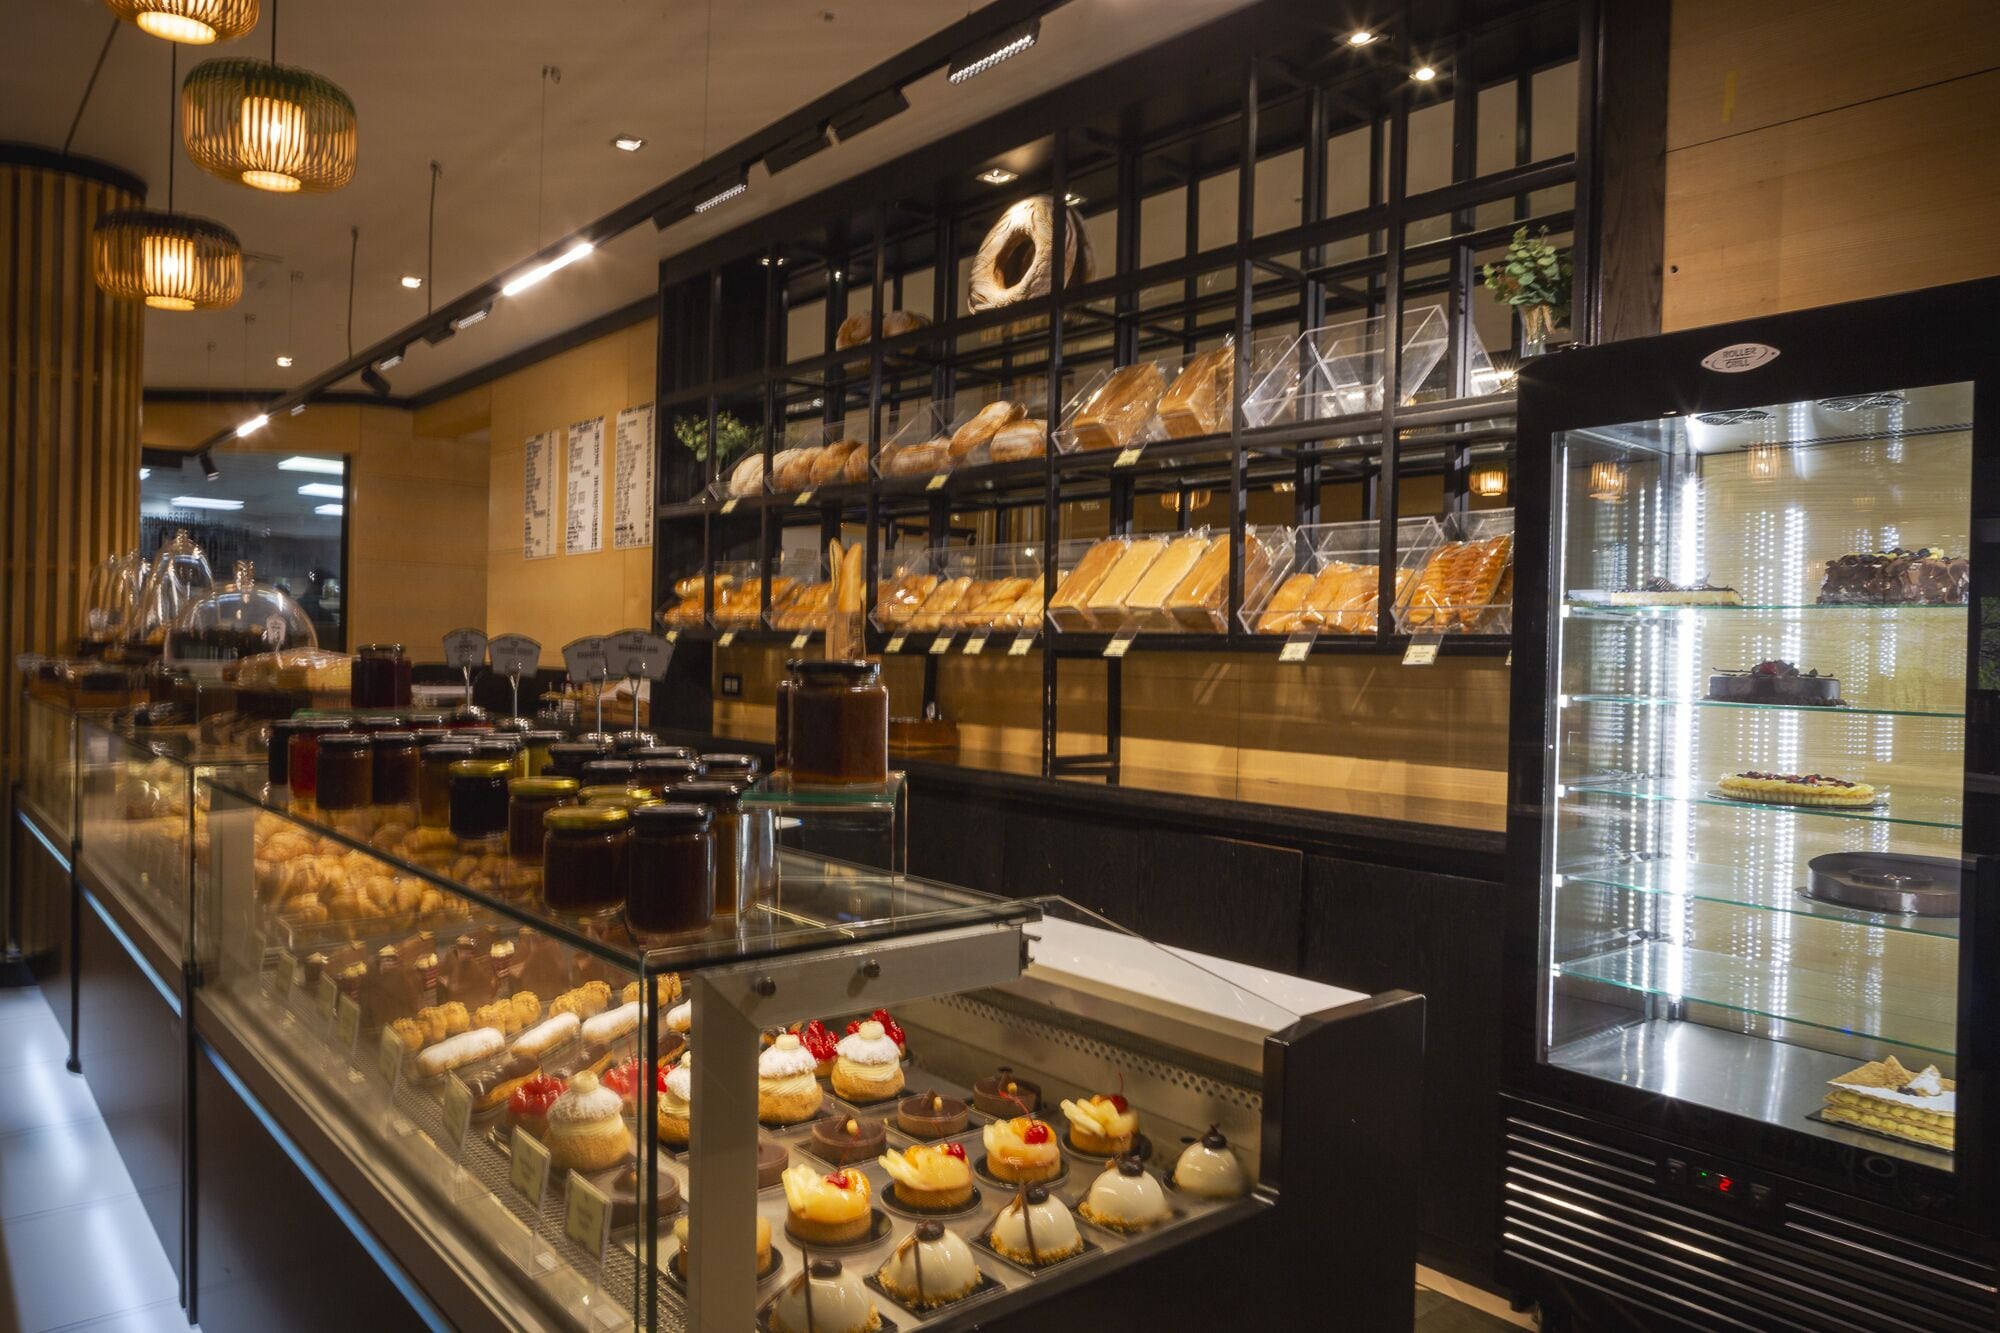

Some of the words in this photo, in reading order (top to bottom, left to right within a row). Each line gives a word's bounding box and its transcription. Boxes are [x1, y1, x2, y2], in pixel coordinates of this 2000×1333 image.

[1722, 347, 1757, 358] ROLLER
[1724, 359, 1750, 369] GRILL
[1719, 1177, 1734, 1192] 2
